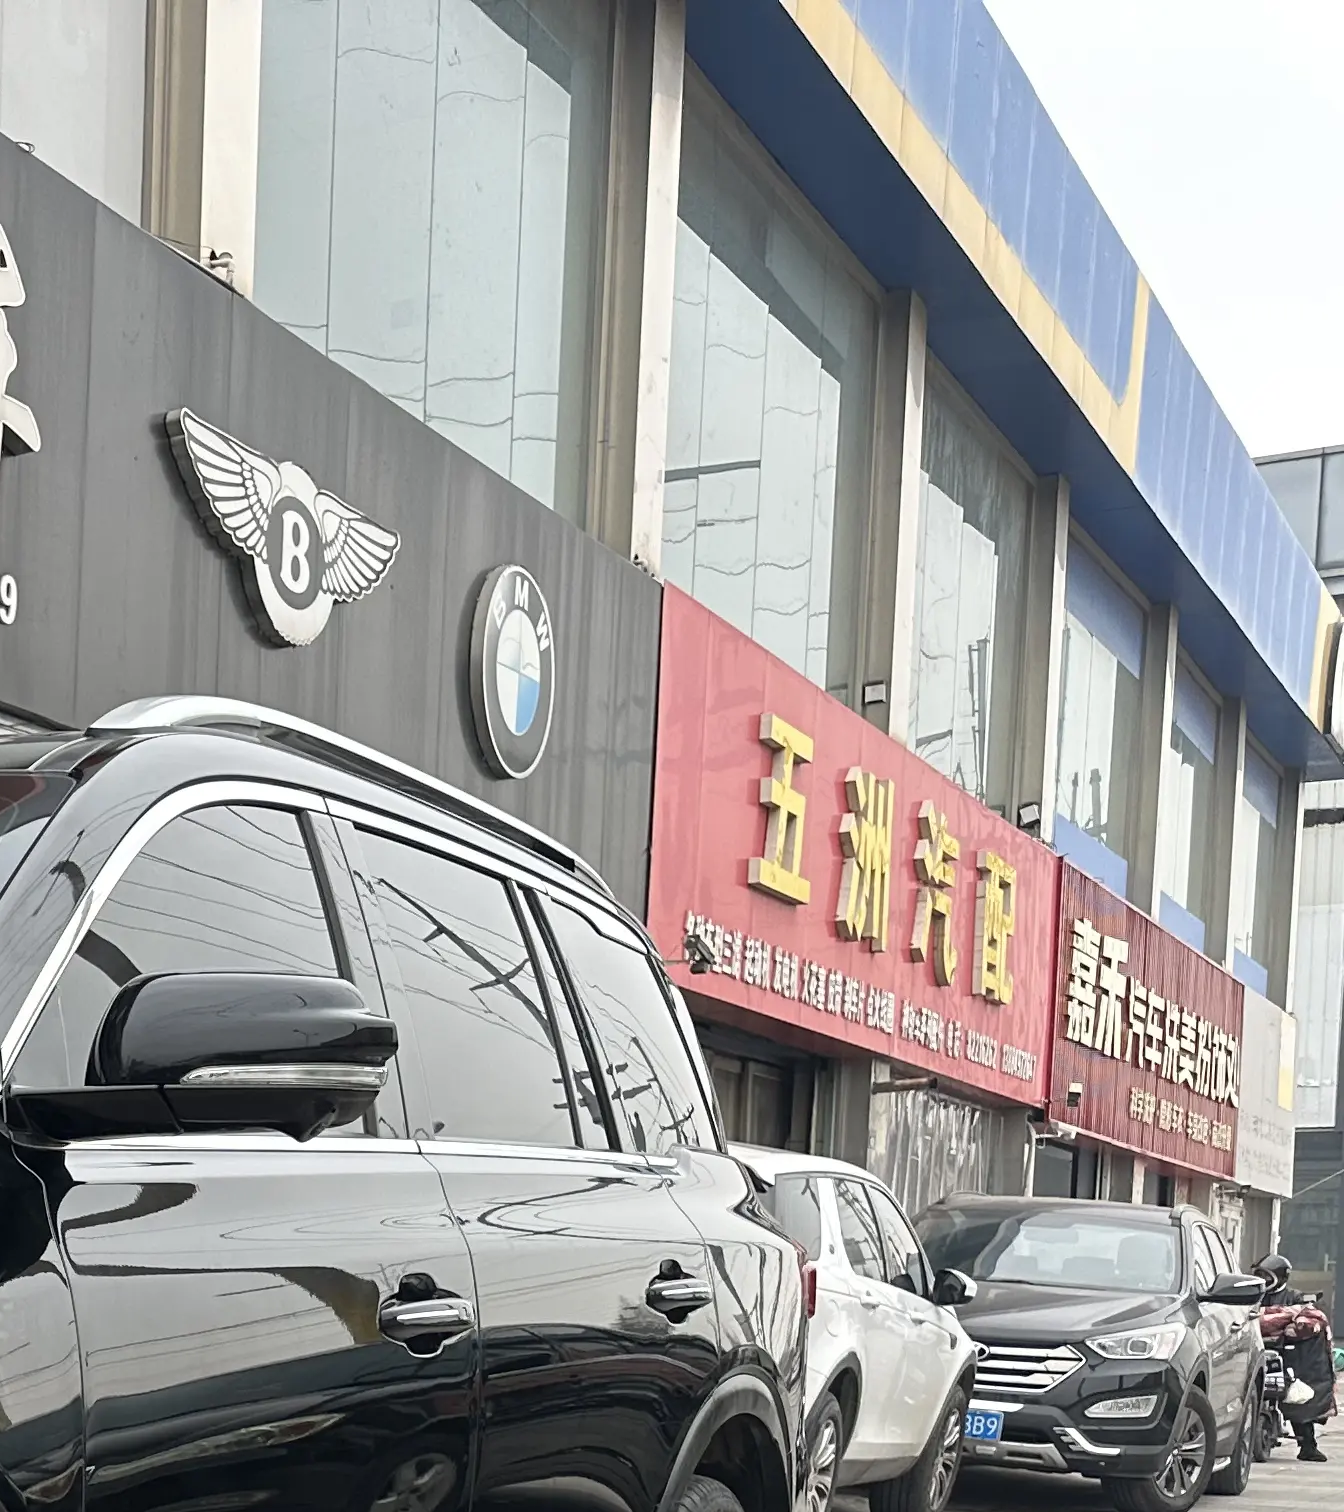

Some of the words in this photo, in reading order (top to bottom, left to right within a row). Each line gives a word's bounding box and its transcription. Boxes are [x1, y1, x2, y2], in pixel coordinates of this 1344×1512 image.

[492, 575, 553, 653] BMW
[748, 713, 1017, 1006] 五洲汽配
